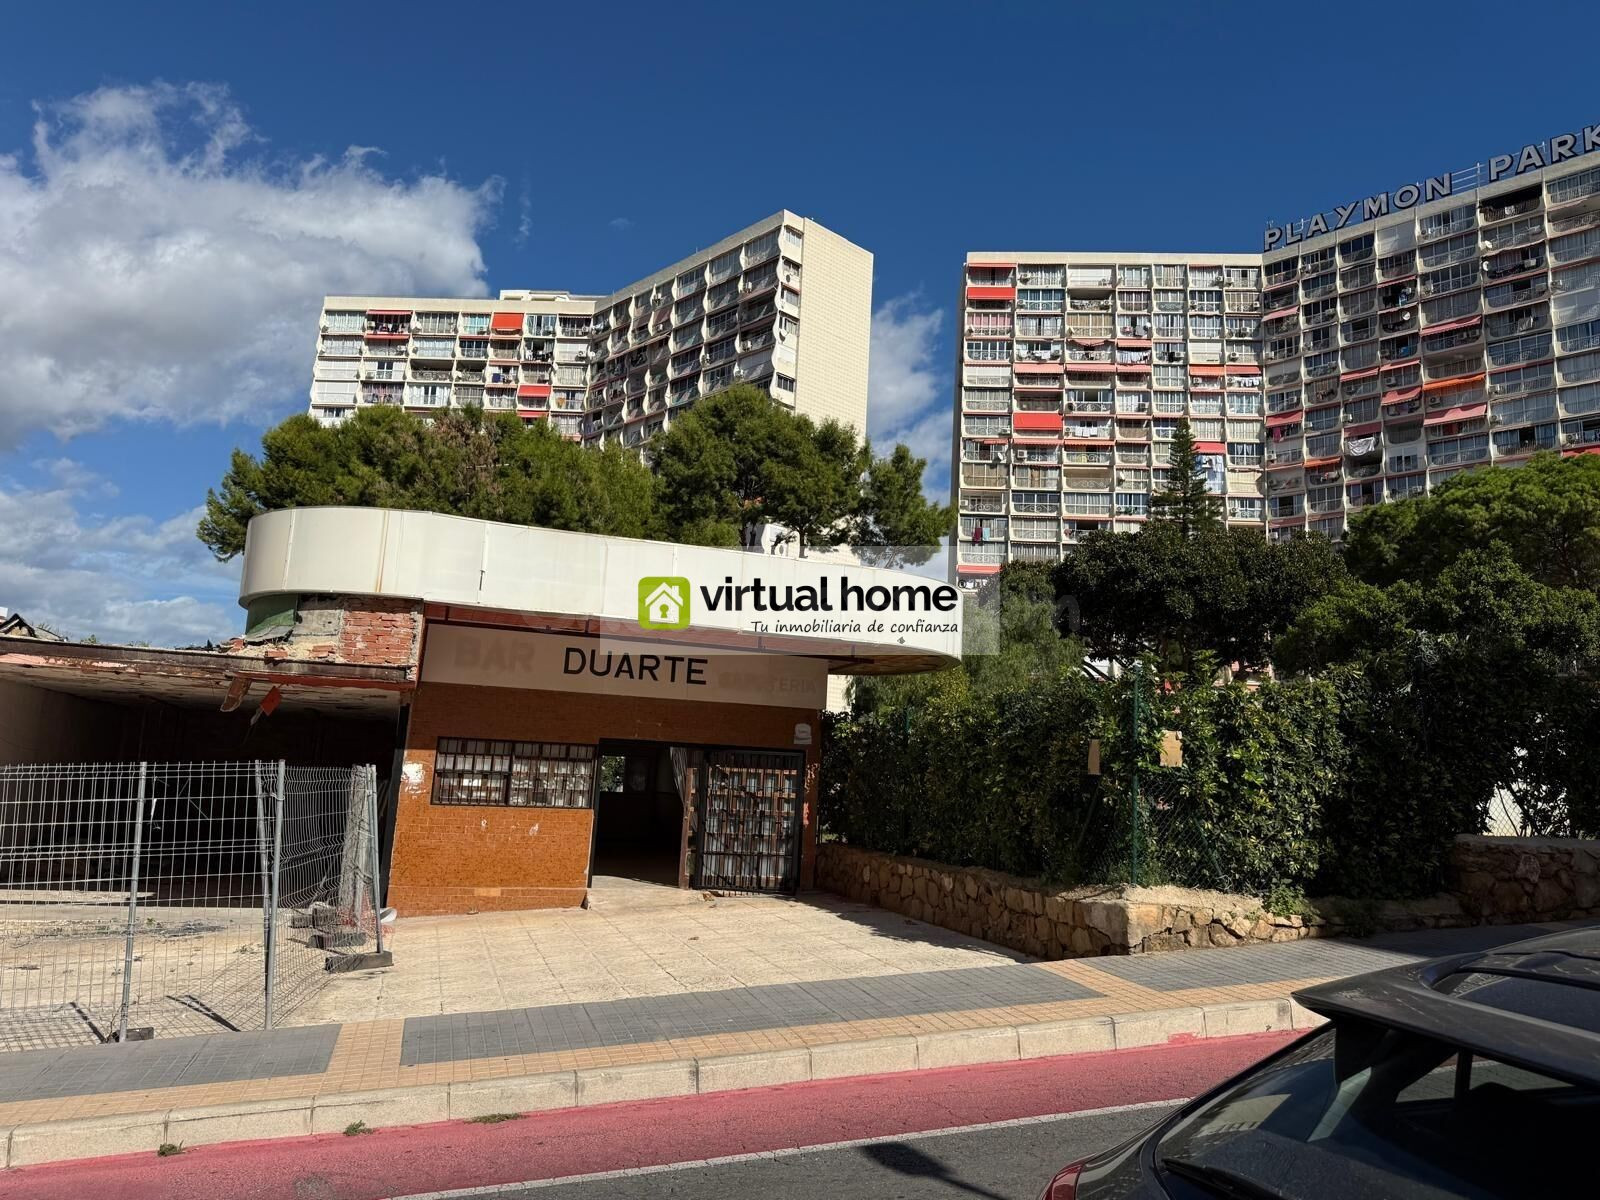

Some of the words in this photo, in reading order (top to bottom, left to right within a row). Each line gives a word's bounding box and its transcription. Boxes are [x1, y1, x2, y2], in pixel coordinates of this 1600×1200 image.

[1263, 172, 1452, 251] PLAYMON
[1489, 124, 1600, 181] PARK
[453, 637, 536, 673] BAR
[563, 647, 709, 686] DUARTE
